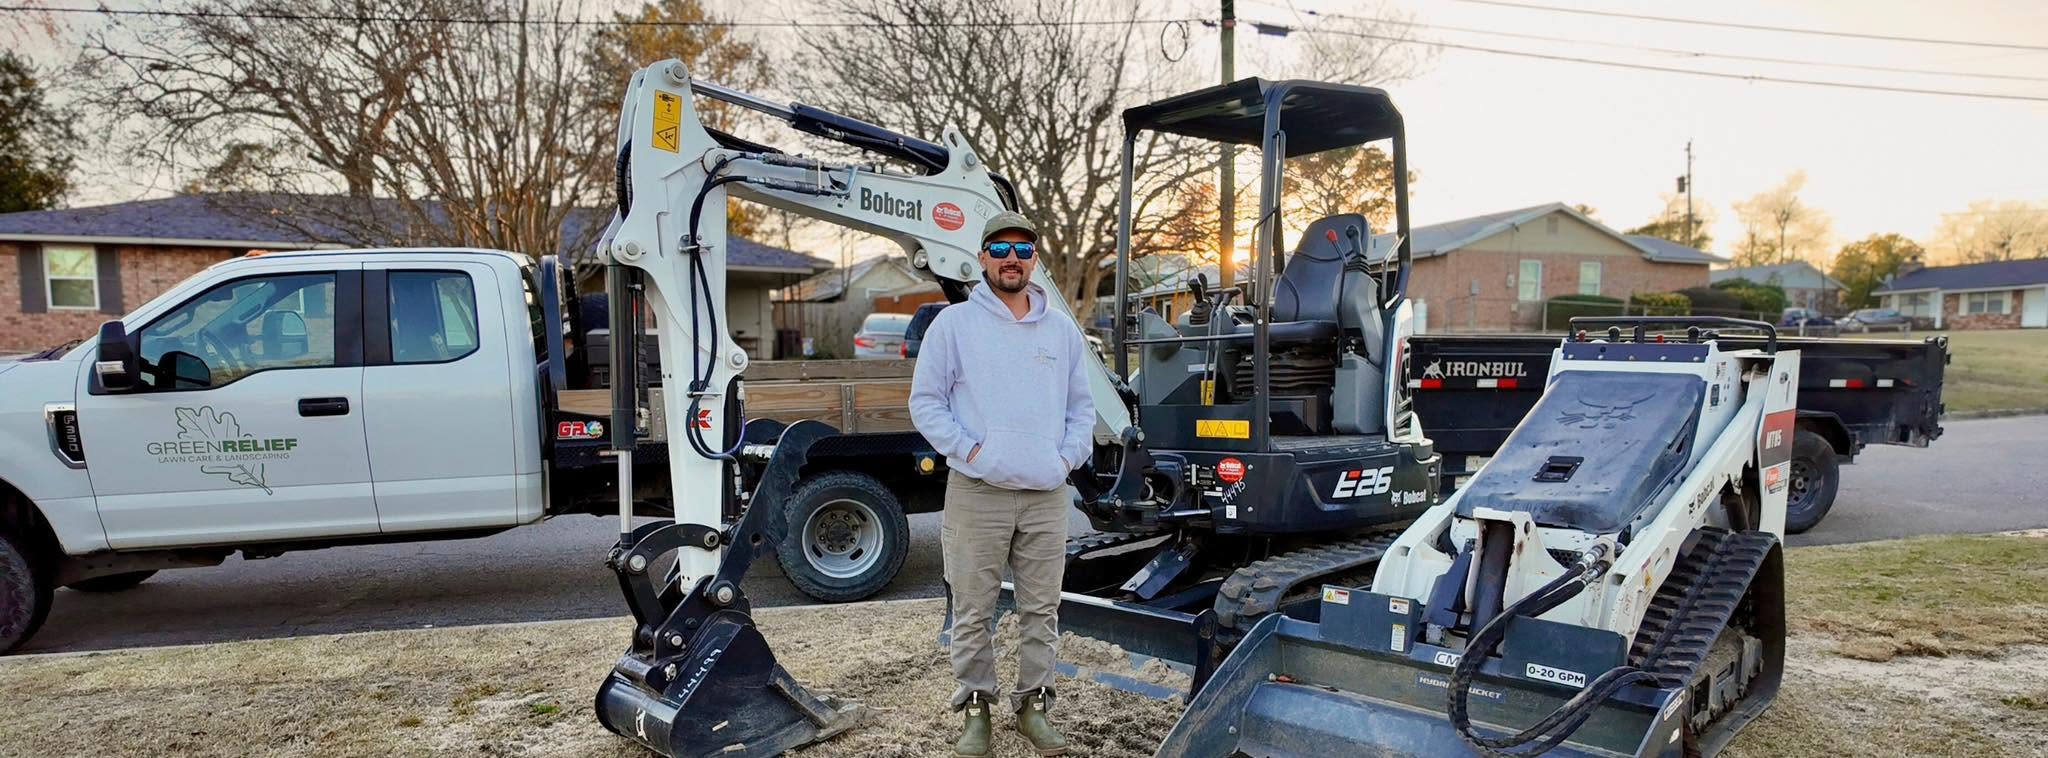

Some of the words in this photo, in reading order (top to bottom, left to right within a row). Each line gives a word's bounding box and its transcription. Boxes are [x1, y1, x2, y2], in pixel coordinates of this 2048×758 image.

[860, 186, 922, 222] Bobcat
[1445, 361, 1527, 377] IRONBUL
[146, 438, 298, 456] GREENRELIEF
[158, 456, 187, 464] LAWN
[188, 455, 212, 463] CARE
[215, 454, 222, 462] &
[224, 452, 291, 462] LANDSCAPING
[1221, 476, 1246, 504] 44495
[1332, 466, 1394, 498] E26
[1403, 489, 1427, 505] Bobcat
[1437, 653, 1460, 666] CM
[678, 648, 722, 698] 44499
[1528, 666, 1555, 679] 0-20
[1558, 672, 1584, 685] GPM
[1468, 687, 1502, 699] UCKET
